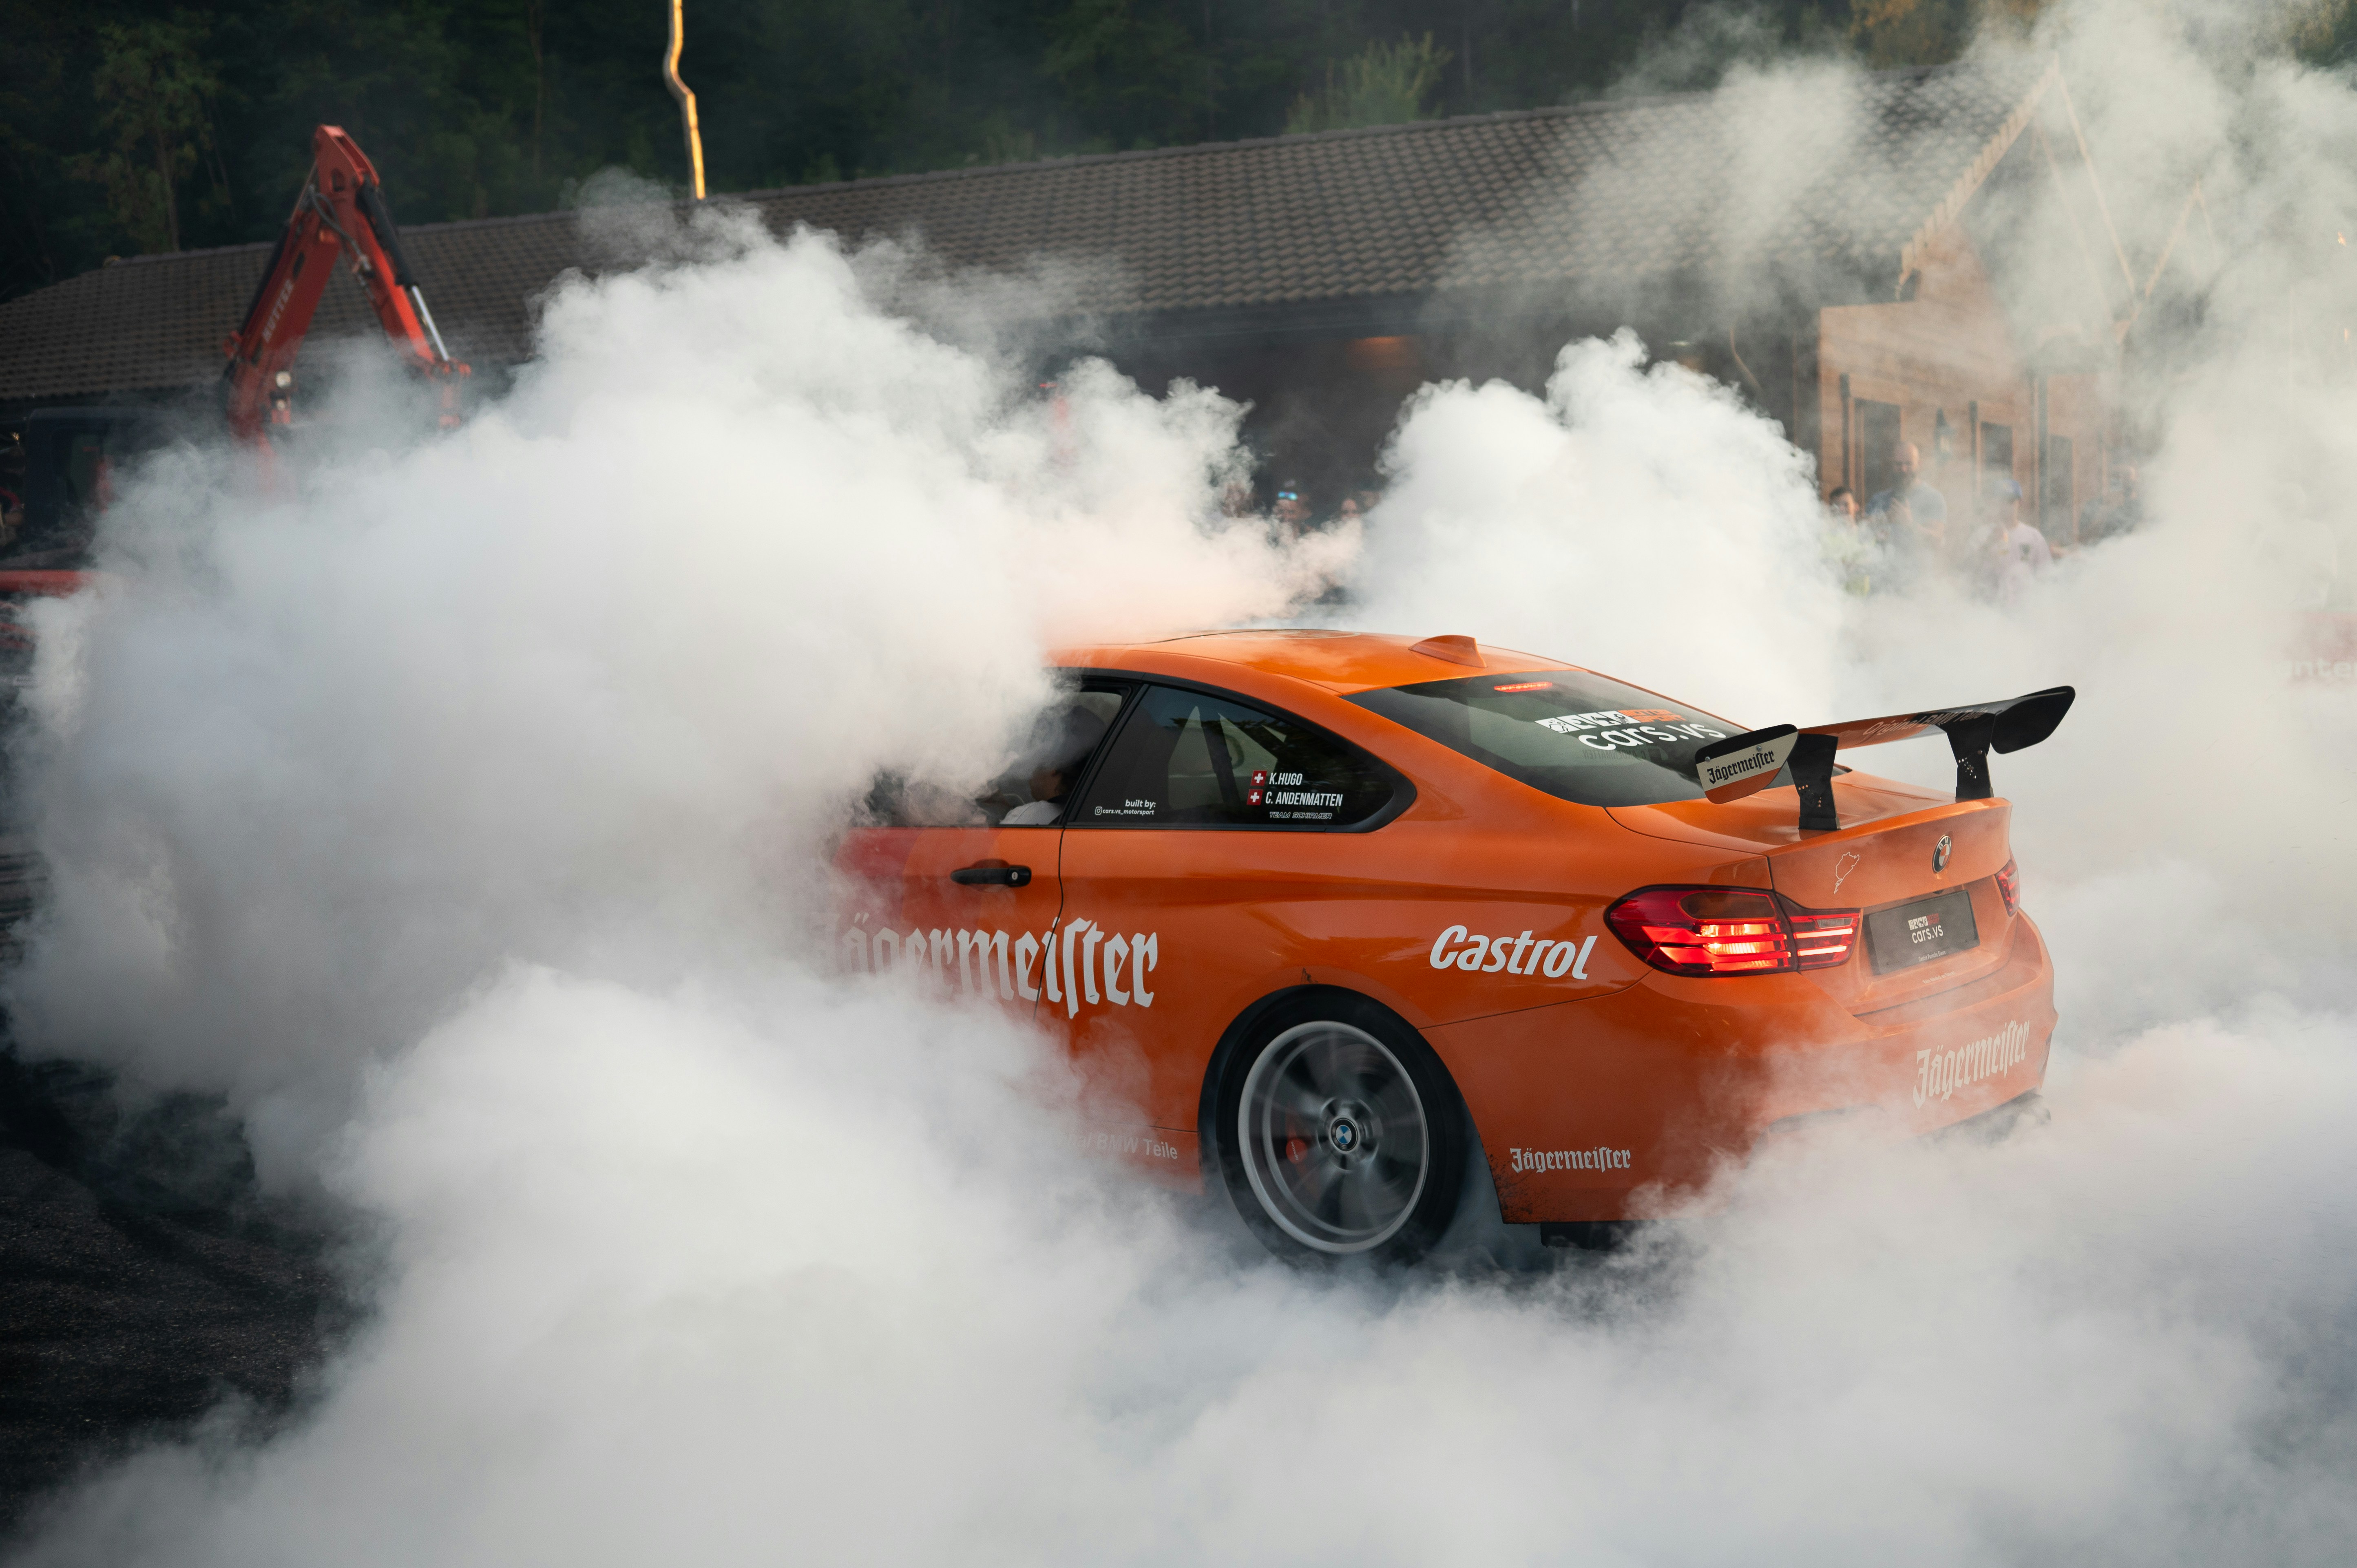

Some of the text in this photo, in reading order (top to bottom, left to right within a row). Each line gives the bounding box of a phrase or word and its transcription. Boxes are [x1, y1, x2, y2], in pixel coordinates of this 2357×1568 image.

[1863, 716, 1927, 735] Original
[1578, 724, 1726, 750] cars.vs
[1269, 772, 1303, 785] K.HUGO
[1144, 800, 1156, 809] by:
[1265, 791, 1343, 807] C. ANDENMATTEN
[1912, 925, 1944, 944] cars.vs
[1429, 925, 1598, 980] Castrol
[1143, 1138, 1178, 1159] Teile
